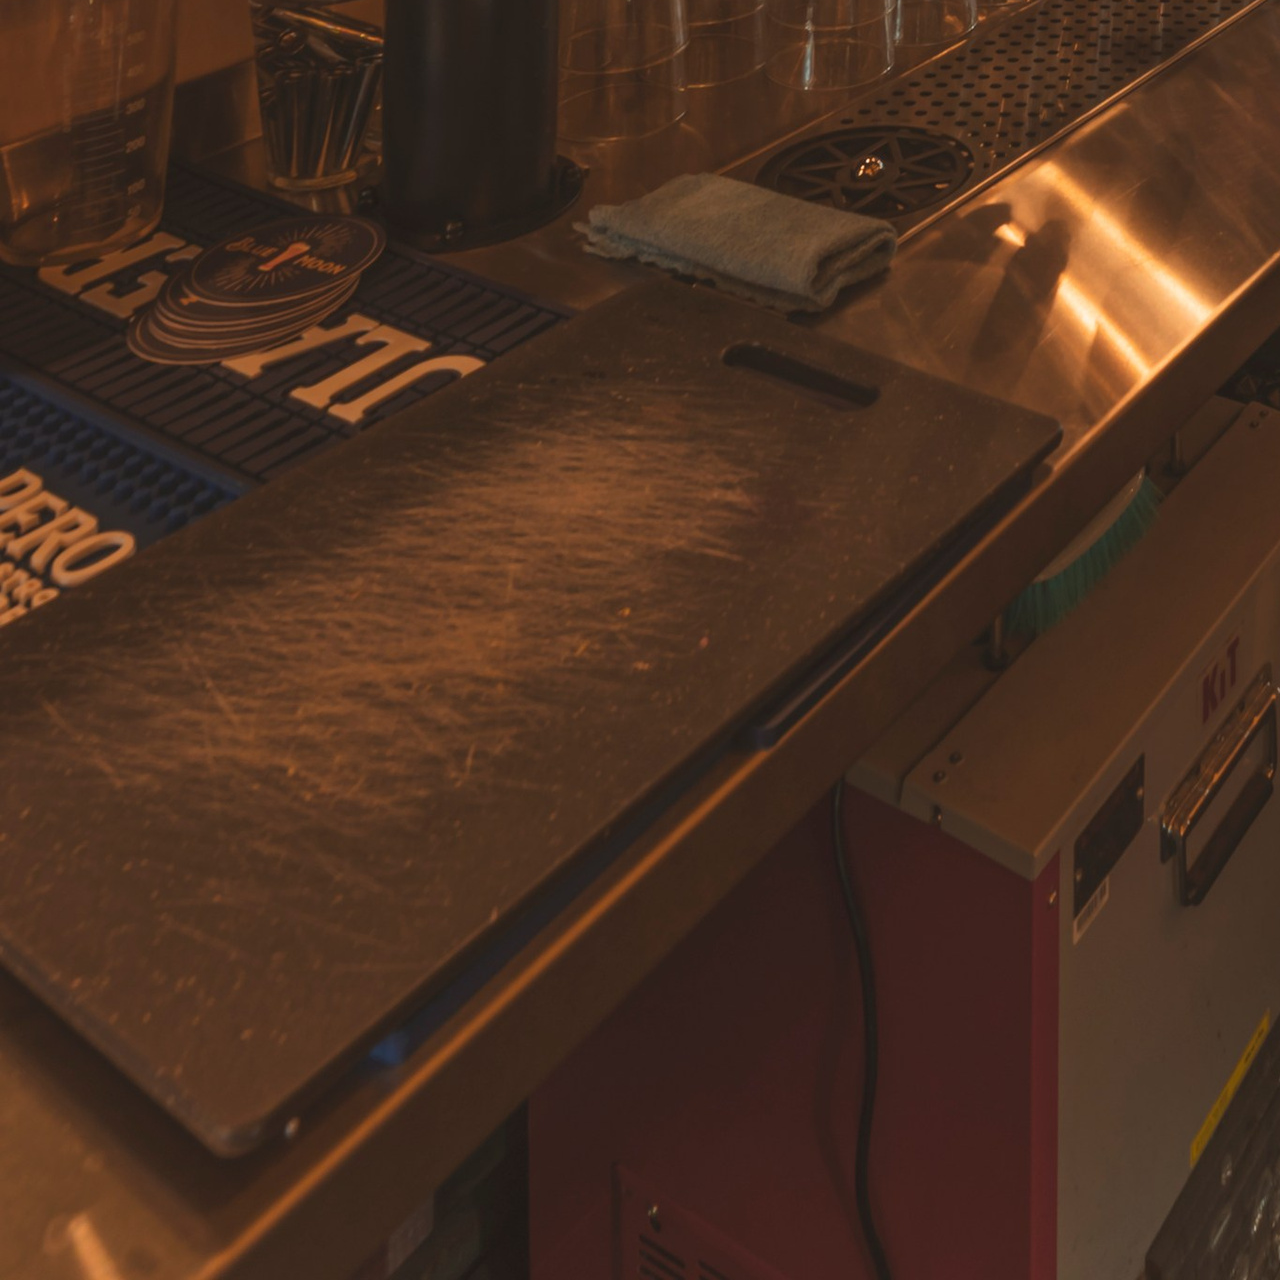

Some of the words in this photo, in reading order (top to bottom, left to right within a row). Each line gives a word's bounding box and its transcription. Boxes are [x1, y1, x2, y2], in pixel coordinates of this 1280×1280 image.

[225, 236, 279, 257] BLUE
[292, 254, 347, 275] MOON
[0, 467, 136, 588] PERO
